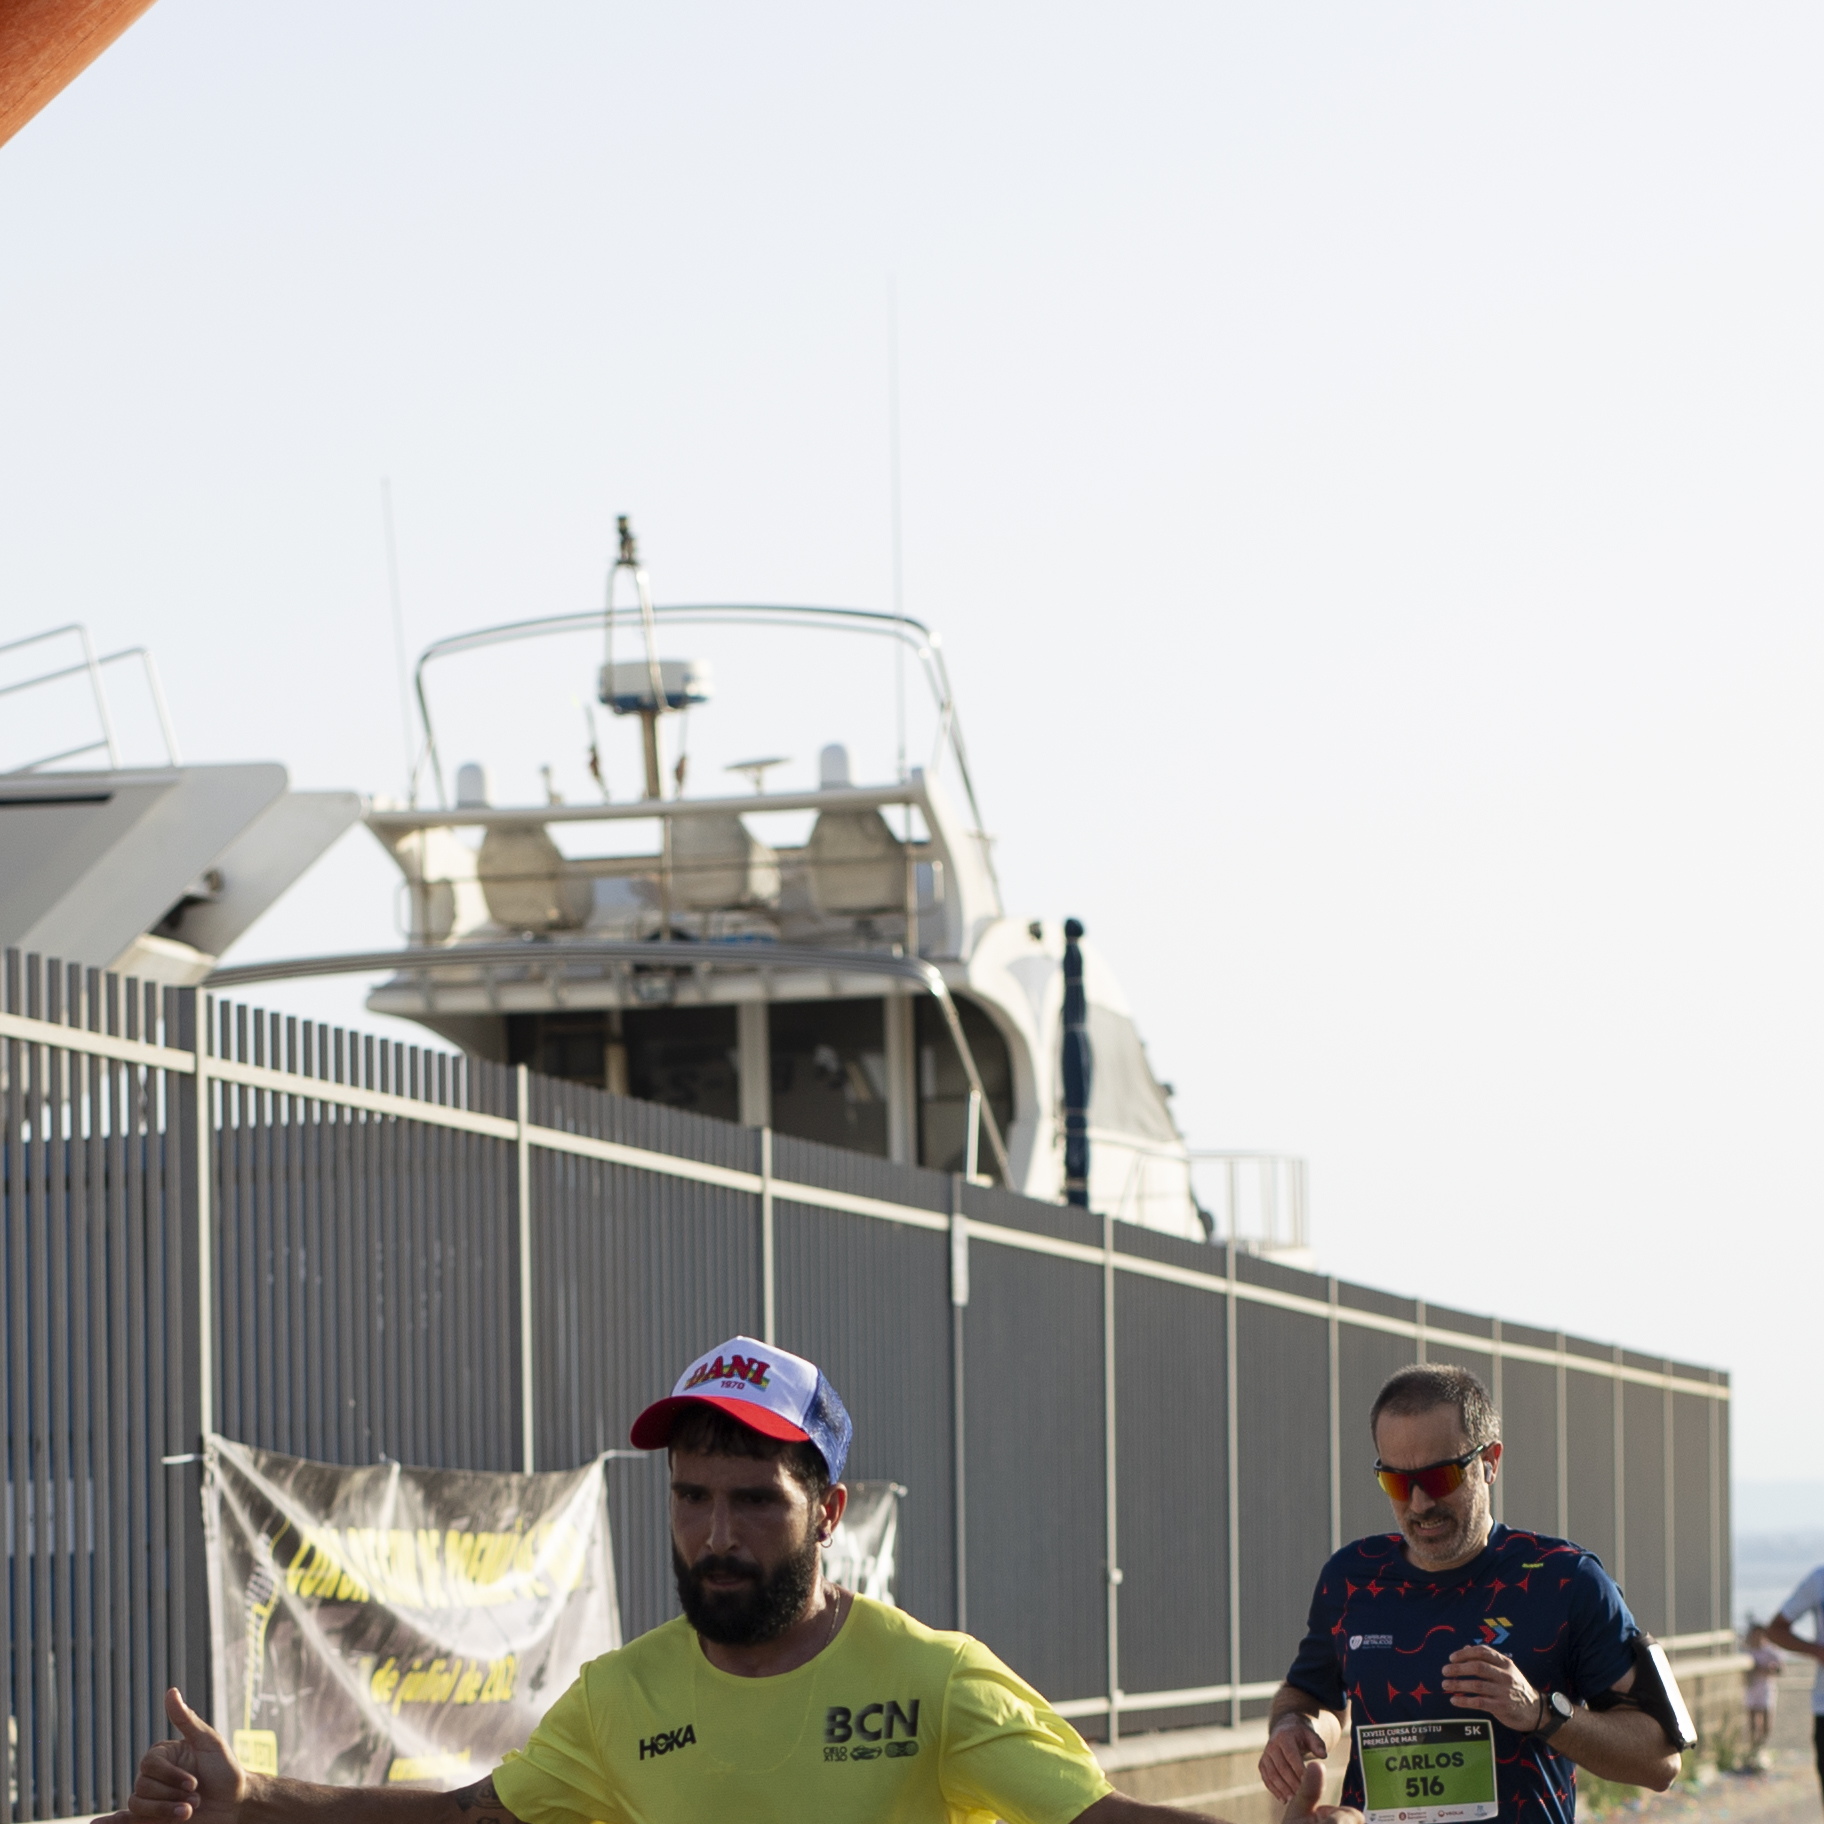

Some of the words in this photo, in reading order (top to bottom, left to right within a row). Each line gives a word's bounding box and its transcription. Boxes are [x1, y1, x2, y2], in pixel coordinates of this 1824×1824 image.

[824, 1699, 920, 1743] BCN
[1387, 1727, 1409, 1736] CURSA
[1464, 1725, 1482, 1736] 5K
[639, 1724, 697, 1760] HOKA
[1390, 1736, 1401, 1744] DE
[1385, 1751, 1465, 1772] CARLOS
[1405, 1775, 1445, 1798] 516
